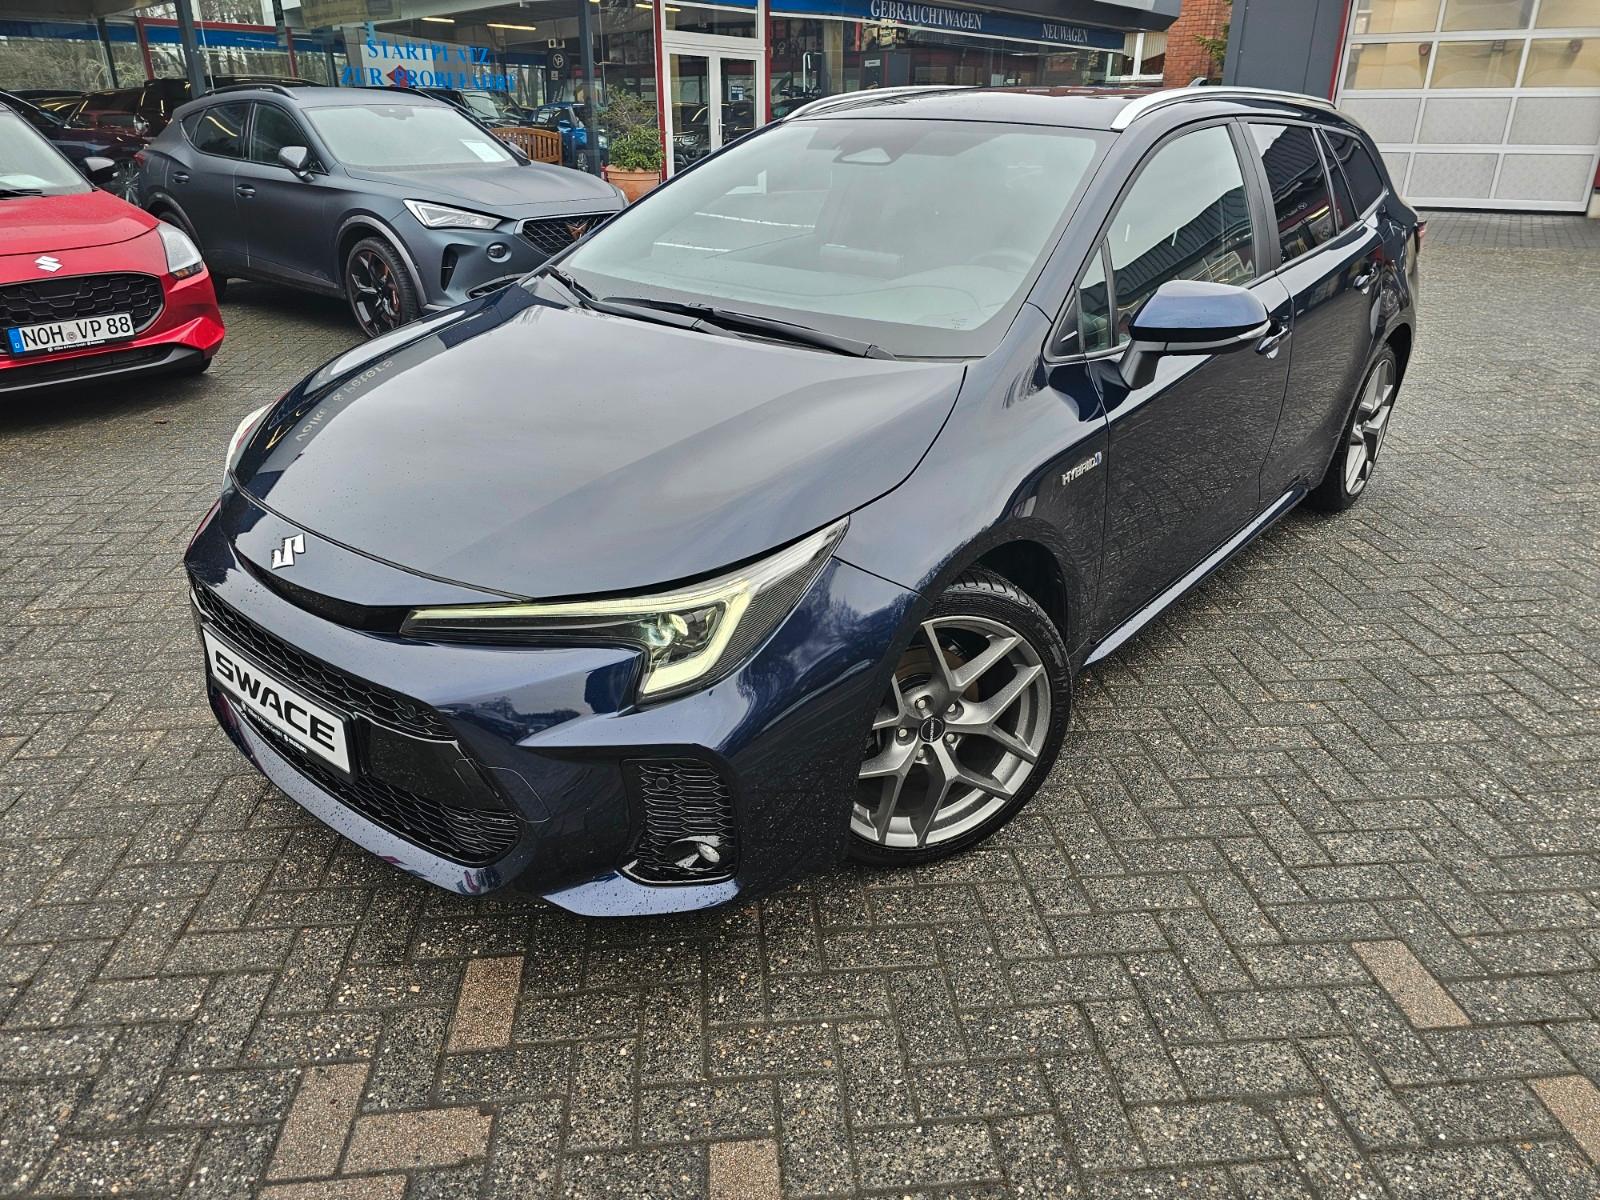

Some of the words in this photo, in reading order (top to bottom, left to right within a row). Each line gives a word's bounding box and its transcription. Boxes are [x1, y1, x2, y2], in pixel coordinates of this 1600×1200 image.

[870, 0, 983, 30] GEBRAUCHTWAGEN
[1041, 23, 1089, 43] NEUWAGEN
[367, 39, 491, 65] STARTPLATZ
[340, 65, 384, 86] ZUR
[21, 325, 65, 348] NOH
[76, 319, 102, 339] VP
[106, 316, 131, 335] 88
[1060, 453, 1098, 486] HYBRID
[215, 650, 335, 752] SWACE
